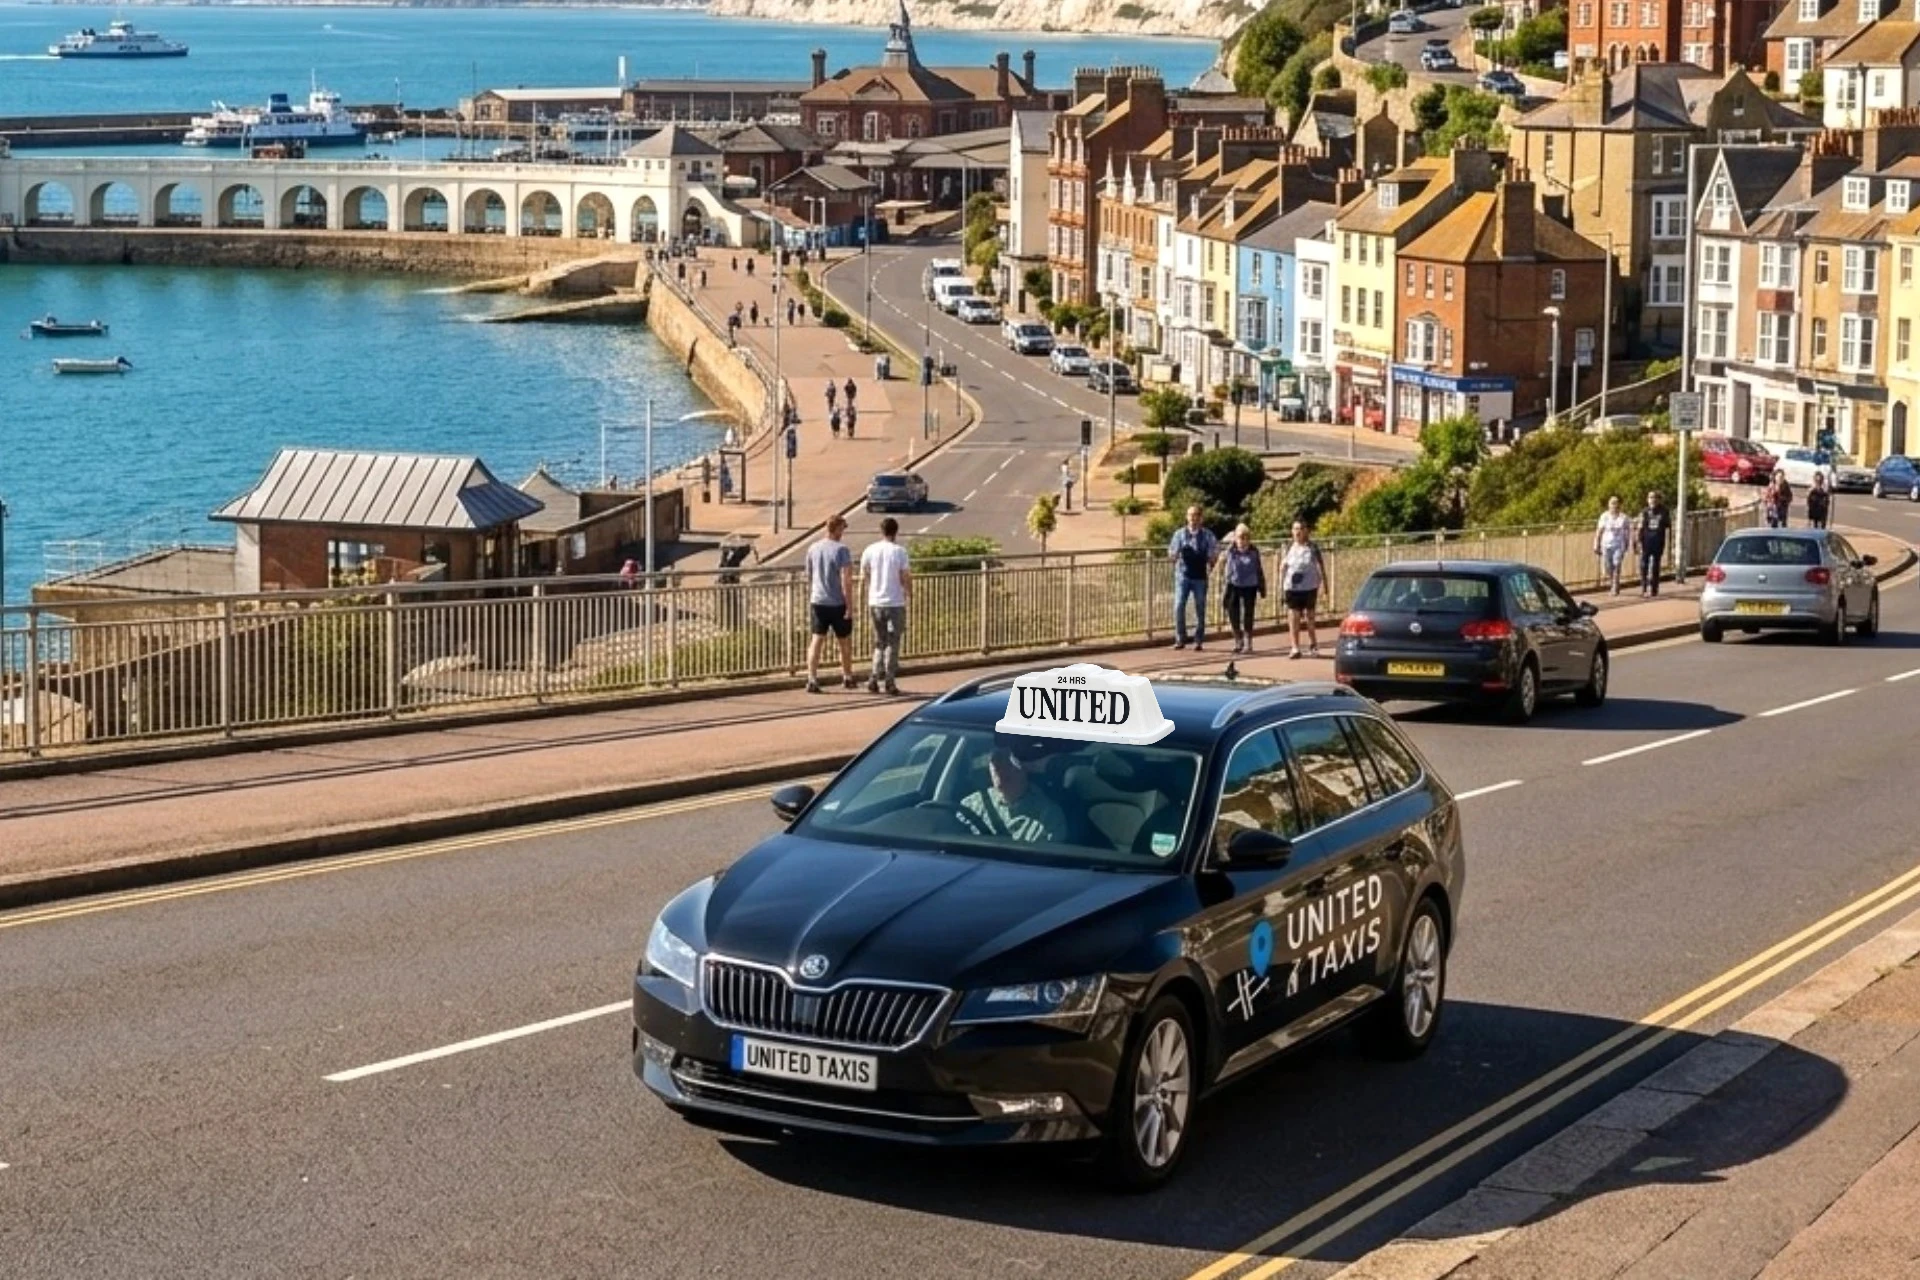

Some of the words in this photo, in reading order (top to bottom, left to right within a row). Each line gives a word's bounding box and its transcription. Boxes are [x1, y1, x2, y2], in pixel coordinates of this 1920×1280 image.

[1057, 676, 1067, 684] 24
[1069, 676, 1086, 685] HRS
[1017, 686, 1130, 725] UNITED
[1287, 874, 1382, 950] UNITED
[1307, 916, 1381, 985] TAXIS
[747, 1043, 811, 1075] UNITED
[816, 1055, 870, 1084] TAXIS
